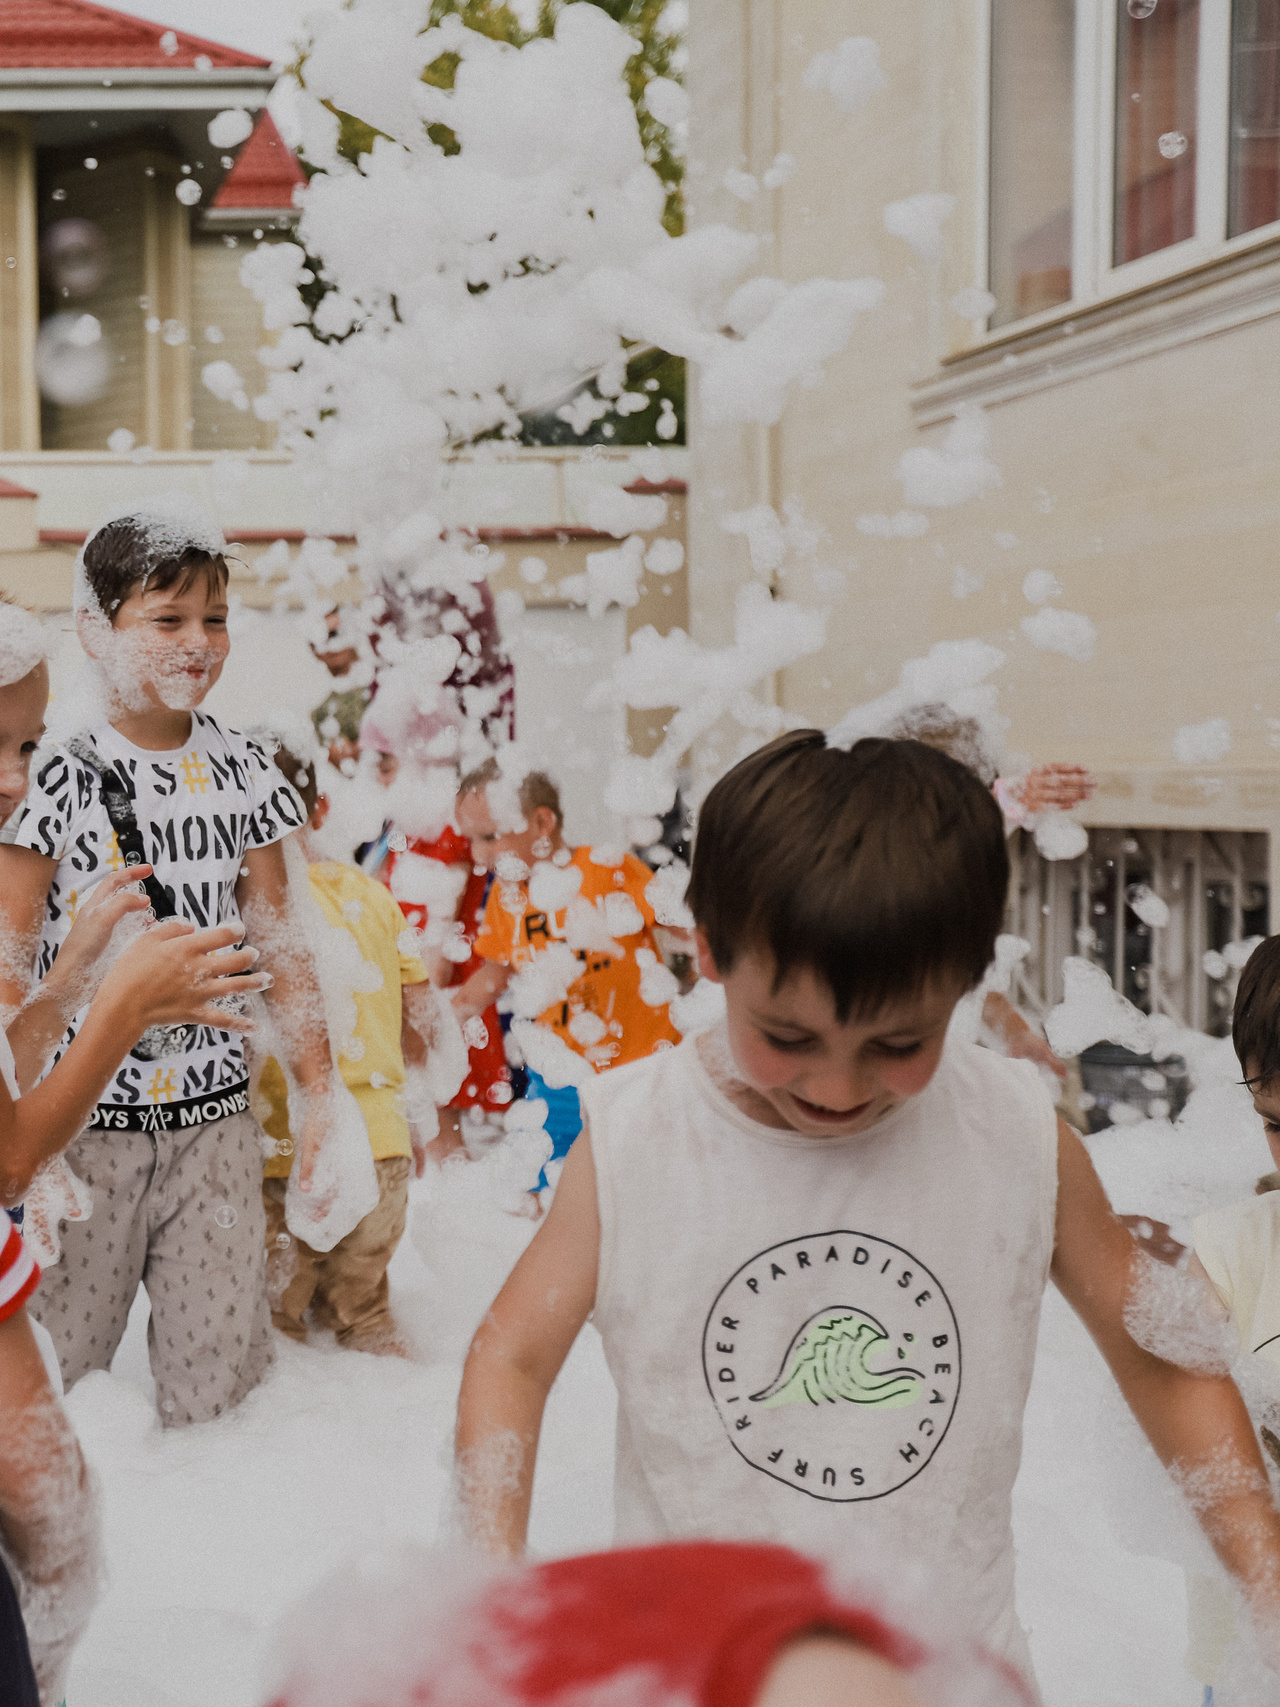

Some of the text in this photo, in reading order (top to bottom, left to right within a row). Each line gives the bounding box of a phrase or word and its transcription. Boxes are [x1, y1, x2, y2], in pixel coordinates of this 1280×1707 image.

[716, 1246, 952, 1486] SURF RIDER PARADISE BEACH
